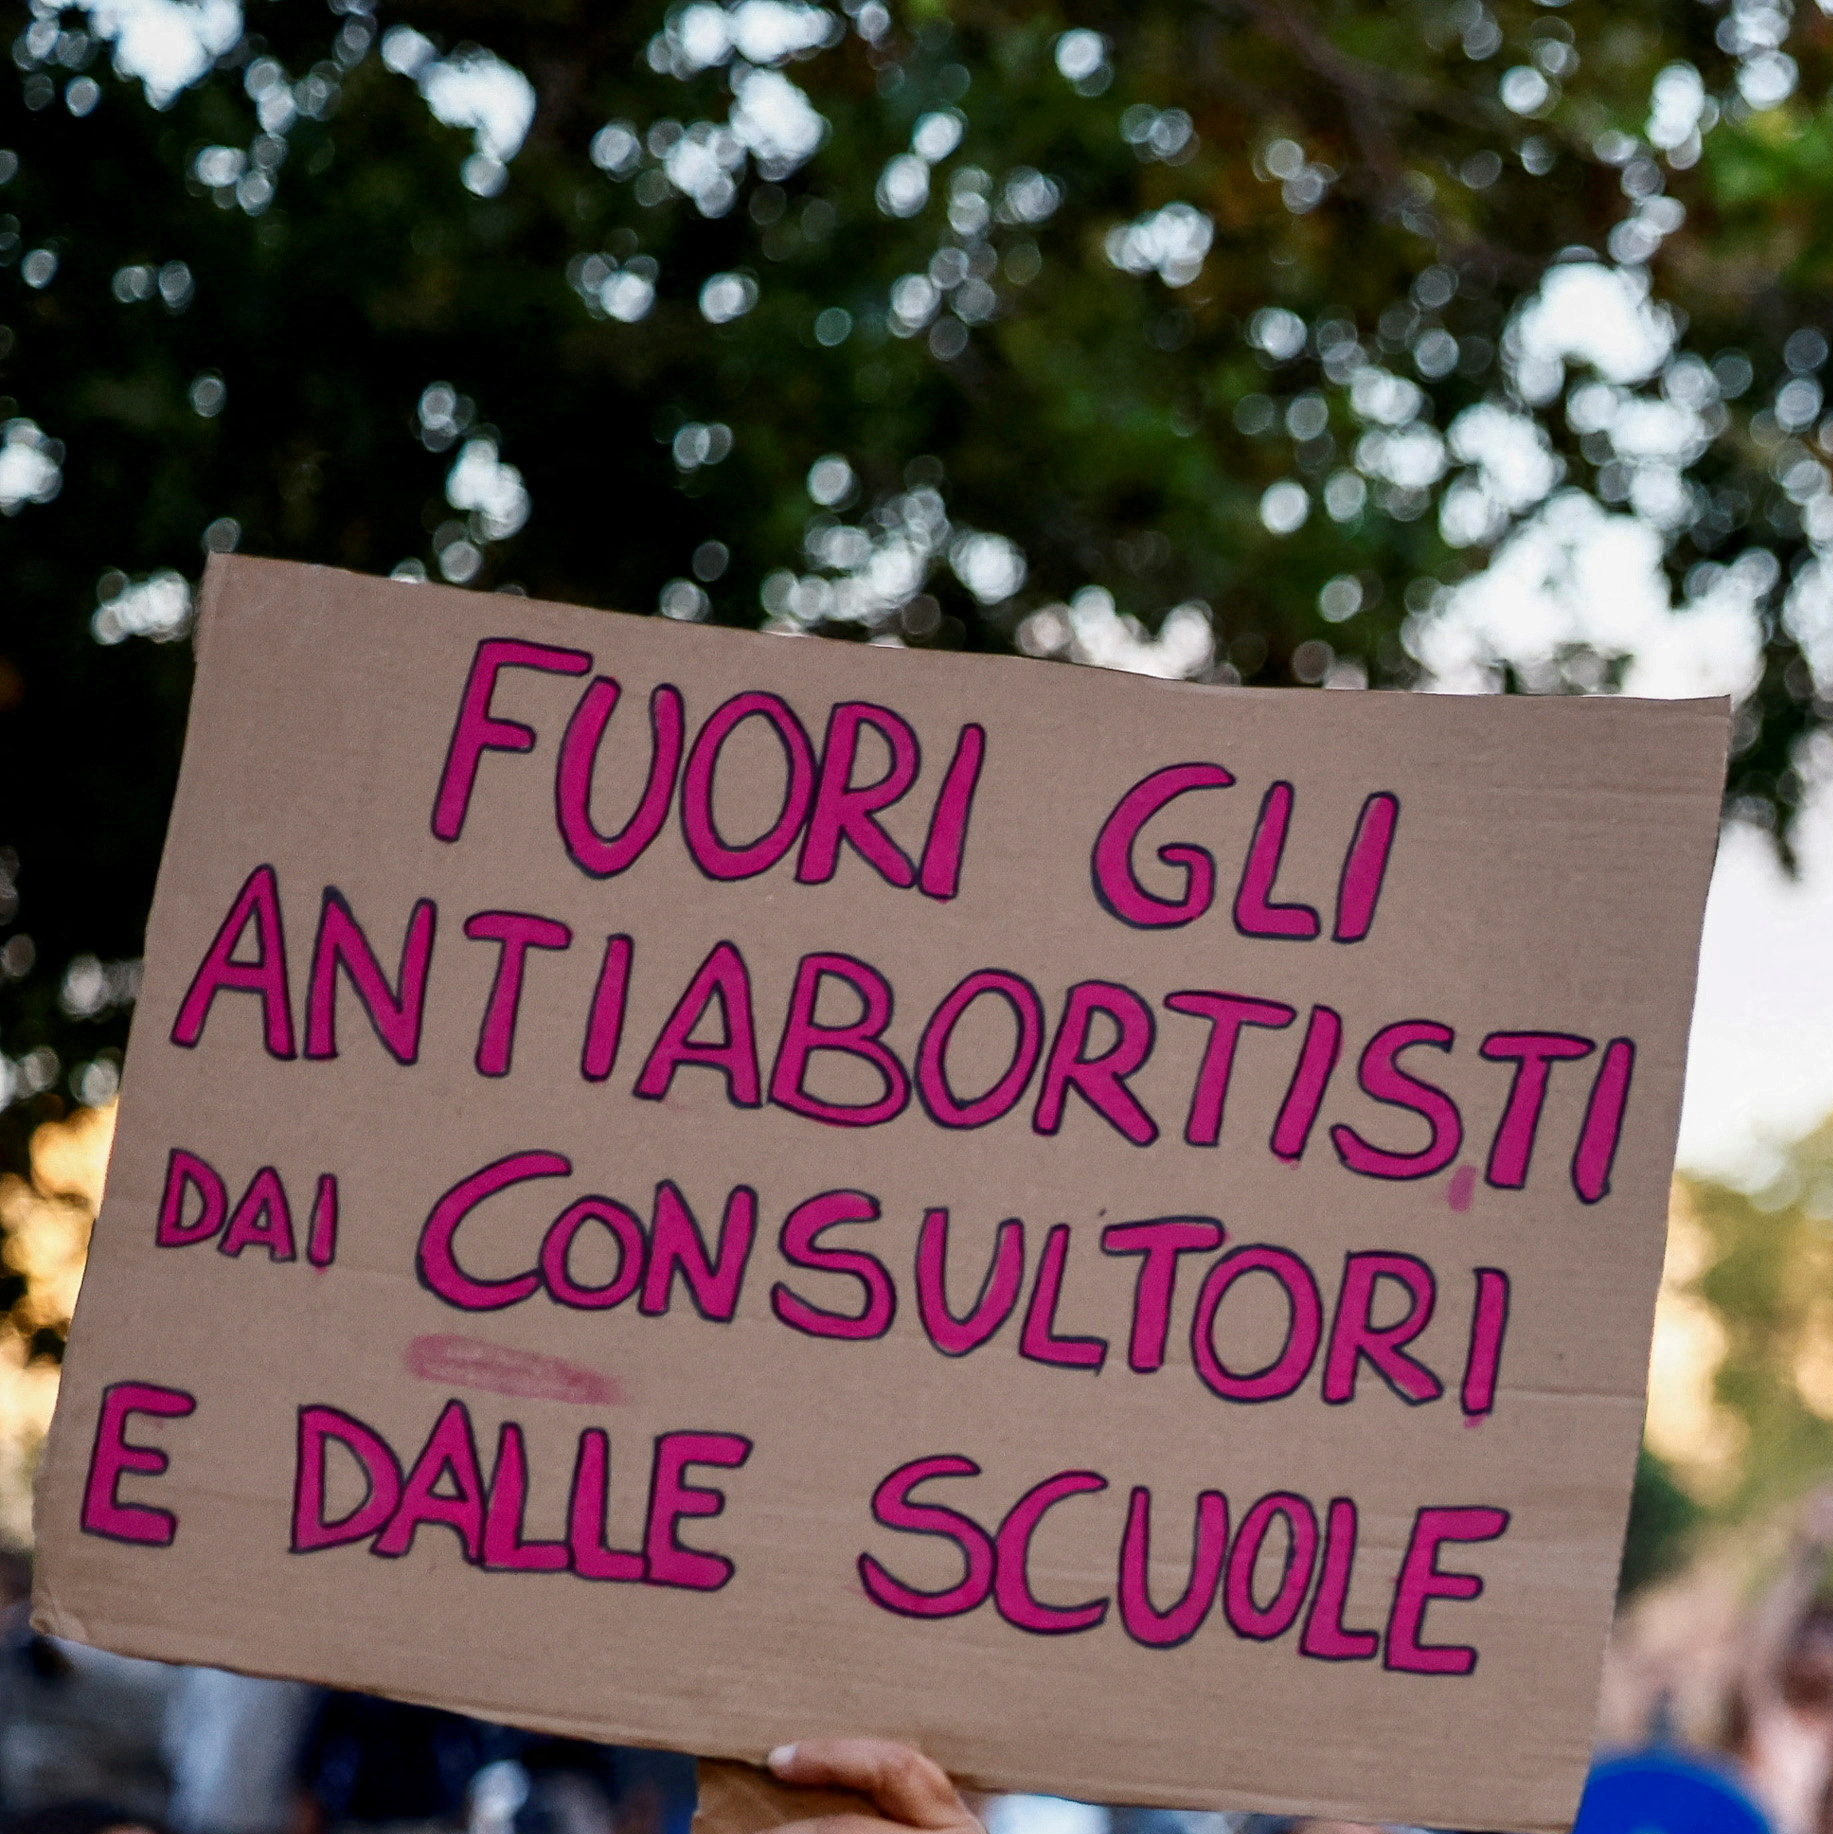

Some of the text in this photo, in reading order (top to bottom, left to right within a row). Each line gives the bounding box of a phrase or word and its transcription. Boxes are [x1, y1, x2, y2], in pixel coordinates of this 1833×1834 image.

[429, 636, 1401, 945] FUORI GLI
[170, 863, 1637, 1206] ANTIABORTISTI
[154, 1147, 1509, 1419] DAI CONSULTORI
[80, 1380, 1511, 1677] E DALLE SCUOLE
